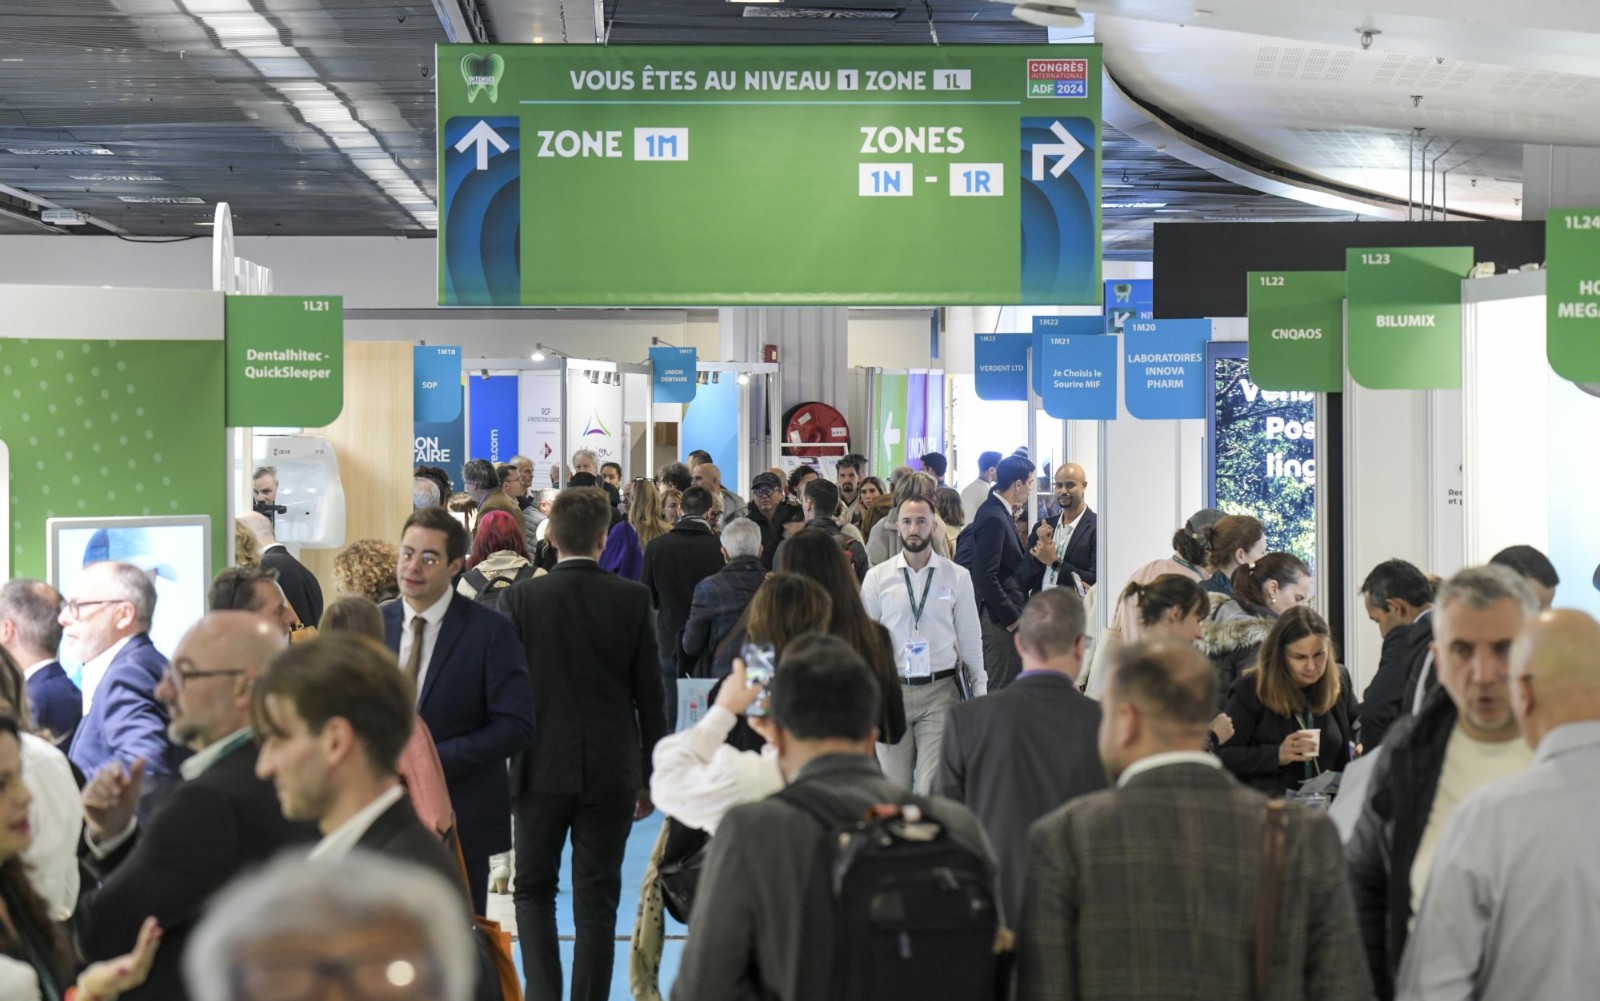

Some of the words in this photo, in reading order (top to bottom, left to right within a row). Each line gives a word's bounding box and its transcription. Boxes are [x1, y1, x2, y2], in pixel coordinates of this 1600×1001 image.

[1031, 61, 1084, 72] CONGRÈS
[570, 70, 635, 90] VOUS
[642, 64, 697, 90] ÊTES
[704, 71, 737, 90] AU
[744, 70, 830, 90] NIVEAU
[845, 73, 851, 89] 1
[865, 70, 926, 90] ZONE
[944, 73, 961, 89] 1L
[1031, 84, 1054, 94] ADF
[1057, 84, 1084, 94] 2024
[537, 130, 623, 158] ZONE
[645, 135, 677, 158] 1M
[860, 126, 965, 154] ZONES
[871, 170, 901, 193] 1N
[962, 170, 991, 193] 1R
[1565, 215, 1600, 229] 1L24
[1361, 254, 1391, 264] 1L23
[1260, 277, 1285, 286] 1L22
[303, 301, 329, 311] 1L21
[1558, 302, 1600, 318] MEG
[1376, 315, 1435, 327] BILUMIX
[1271, 329, 1322, 340] CNQAOS
[246, 349, 322, 361] Dentalhitec
[1128, 354, 1202, 363] LABORATOIRES
[245, 366, 331, 381] QuickSleeper
[1052, 369, 1061, 377] Je
[1063, 369, 1093, 377] Choisis
[1145, 367, 1185, 375] INNOVA
[422, 381, 438, 389] SOP
[1053, 380, 1084, 388] Sourire
[1085, 380, 1101, 388] MIF
[1147, 380, 1184, 388] PHARM
